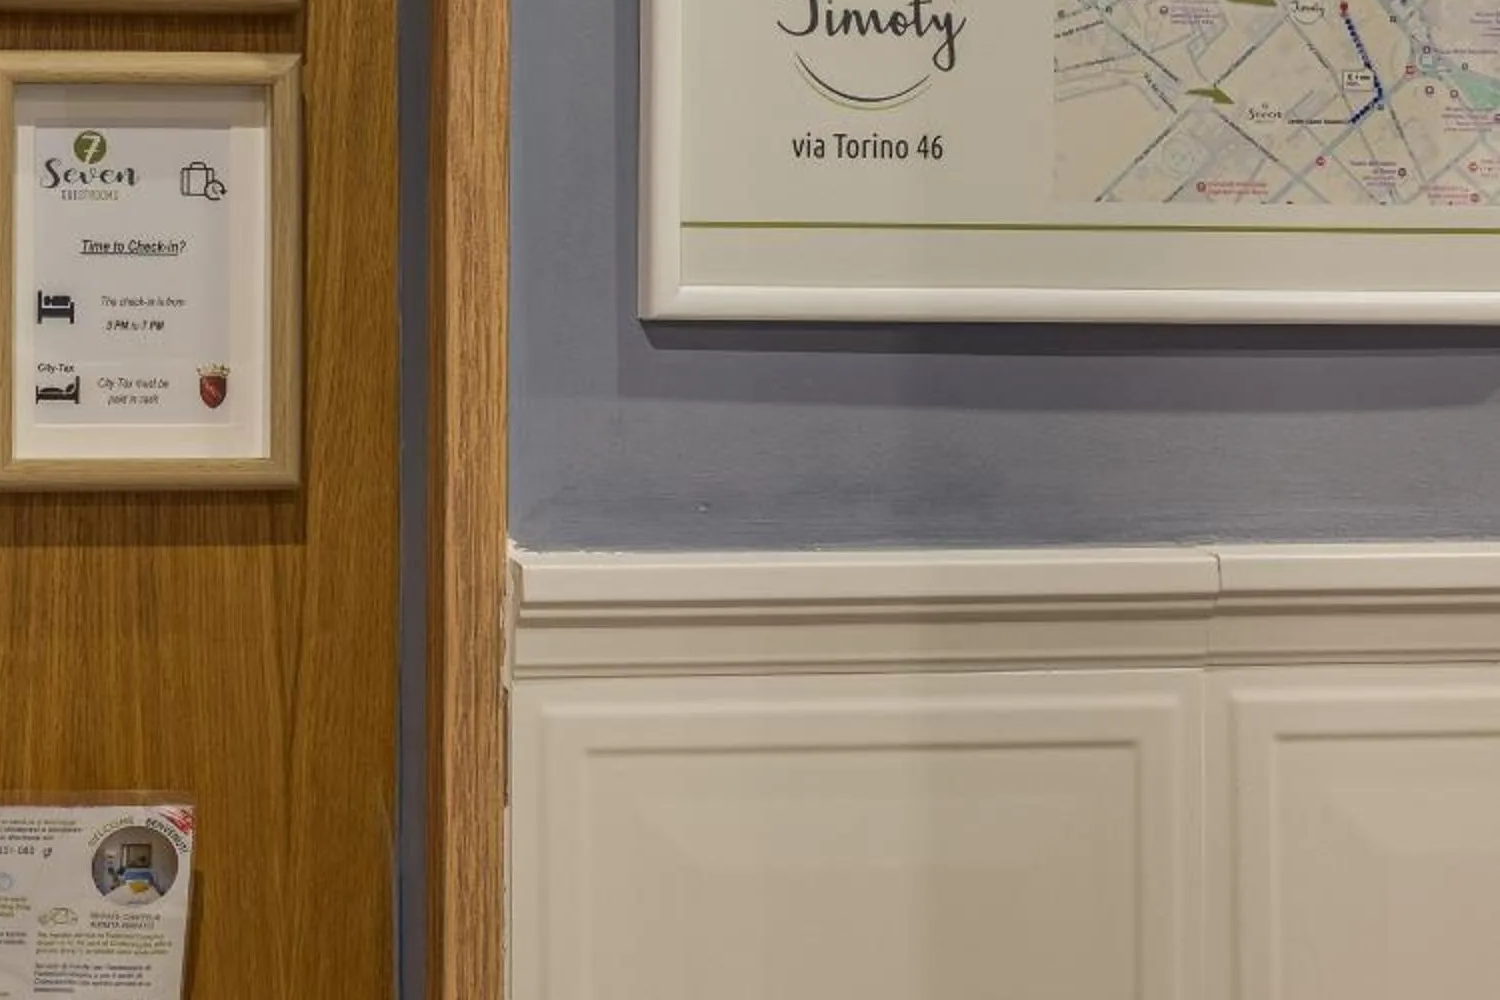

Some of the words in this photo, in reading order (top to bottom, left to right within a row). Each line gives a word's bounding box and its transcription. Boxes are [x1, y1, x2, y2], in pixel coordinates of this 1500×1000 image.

[792, 132, 825, 159] via
[832, 133, 909, 159] Torino
[916, 135, 943, 160] 46
[40, 158, 140, 188] Seven
[82, 239, 111, 252] Time
[115, 240, 125, 251] to
[128, 239, 186, 254] Check-in?
